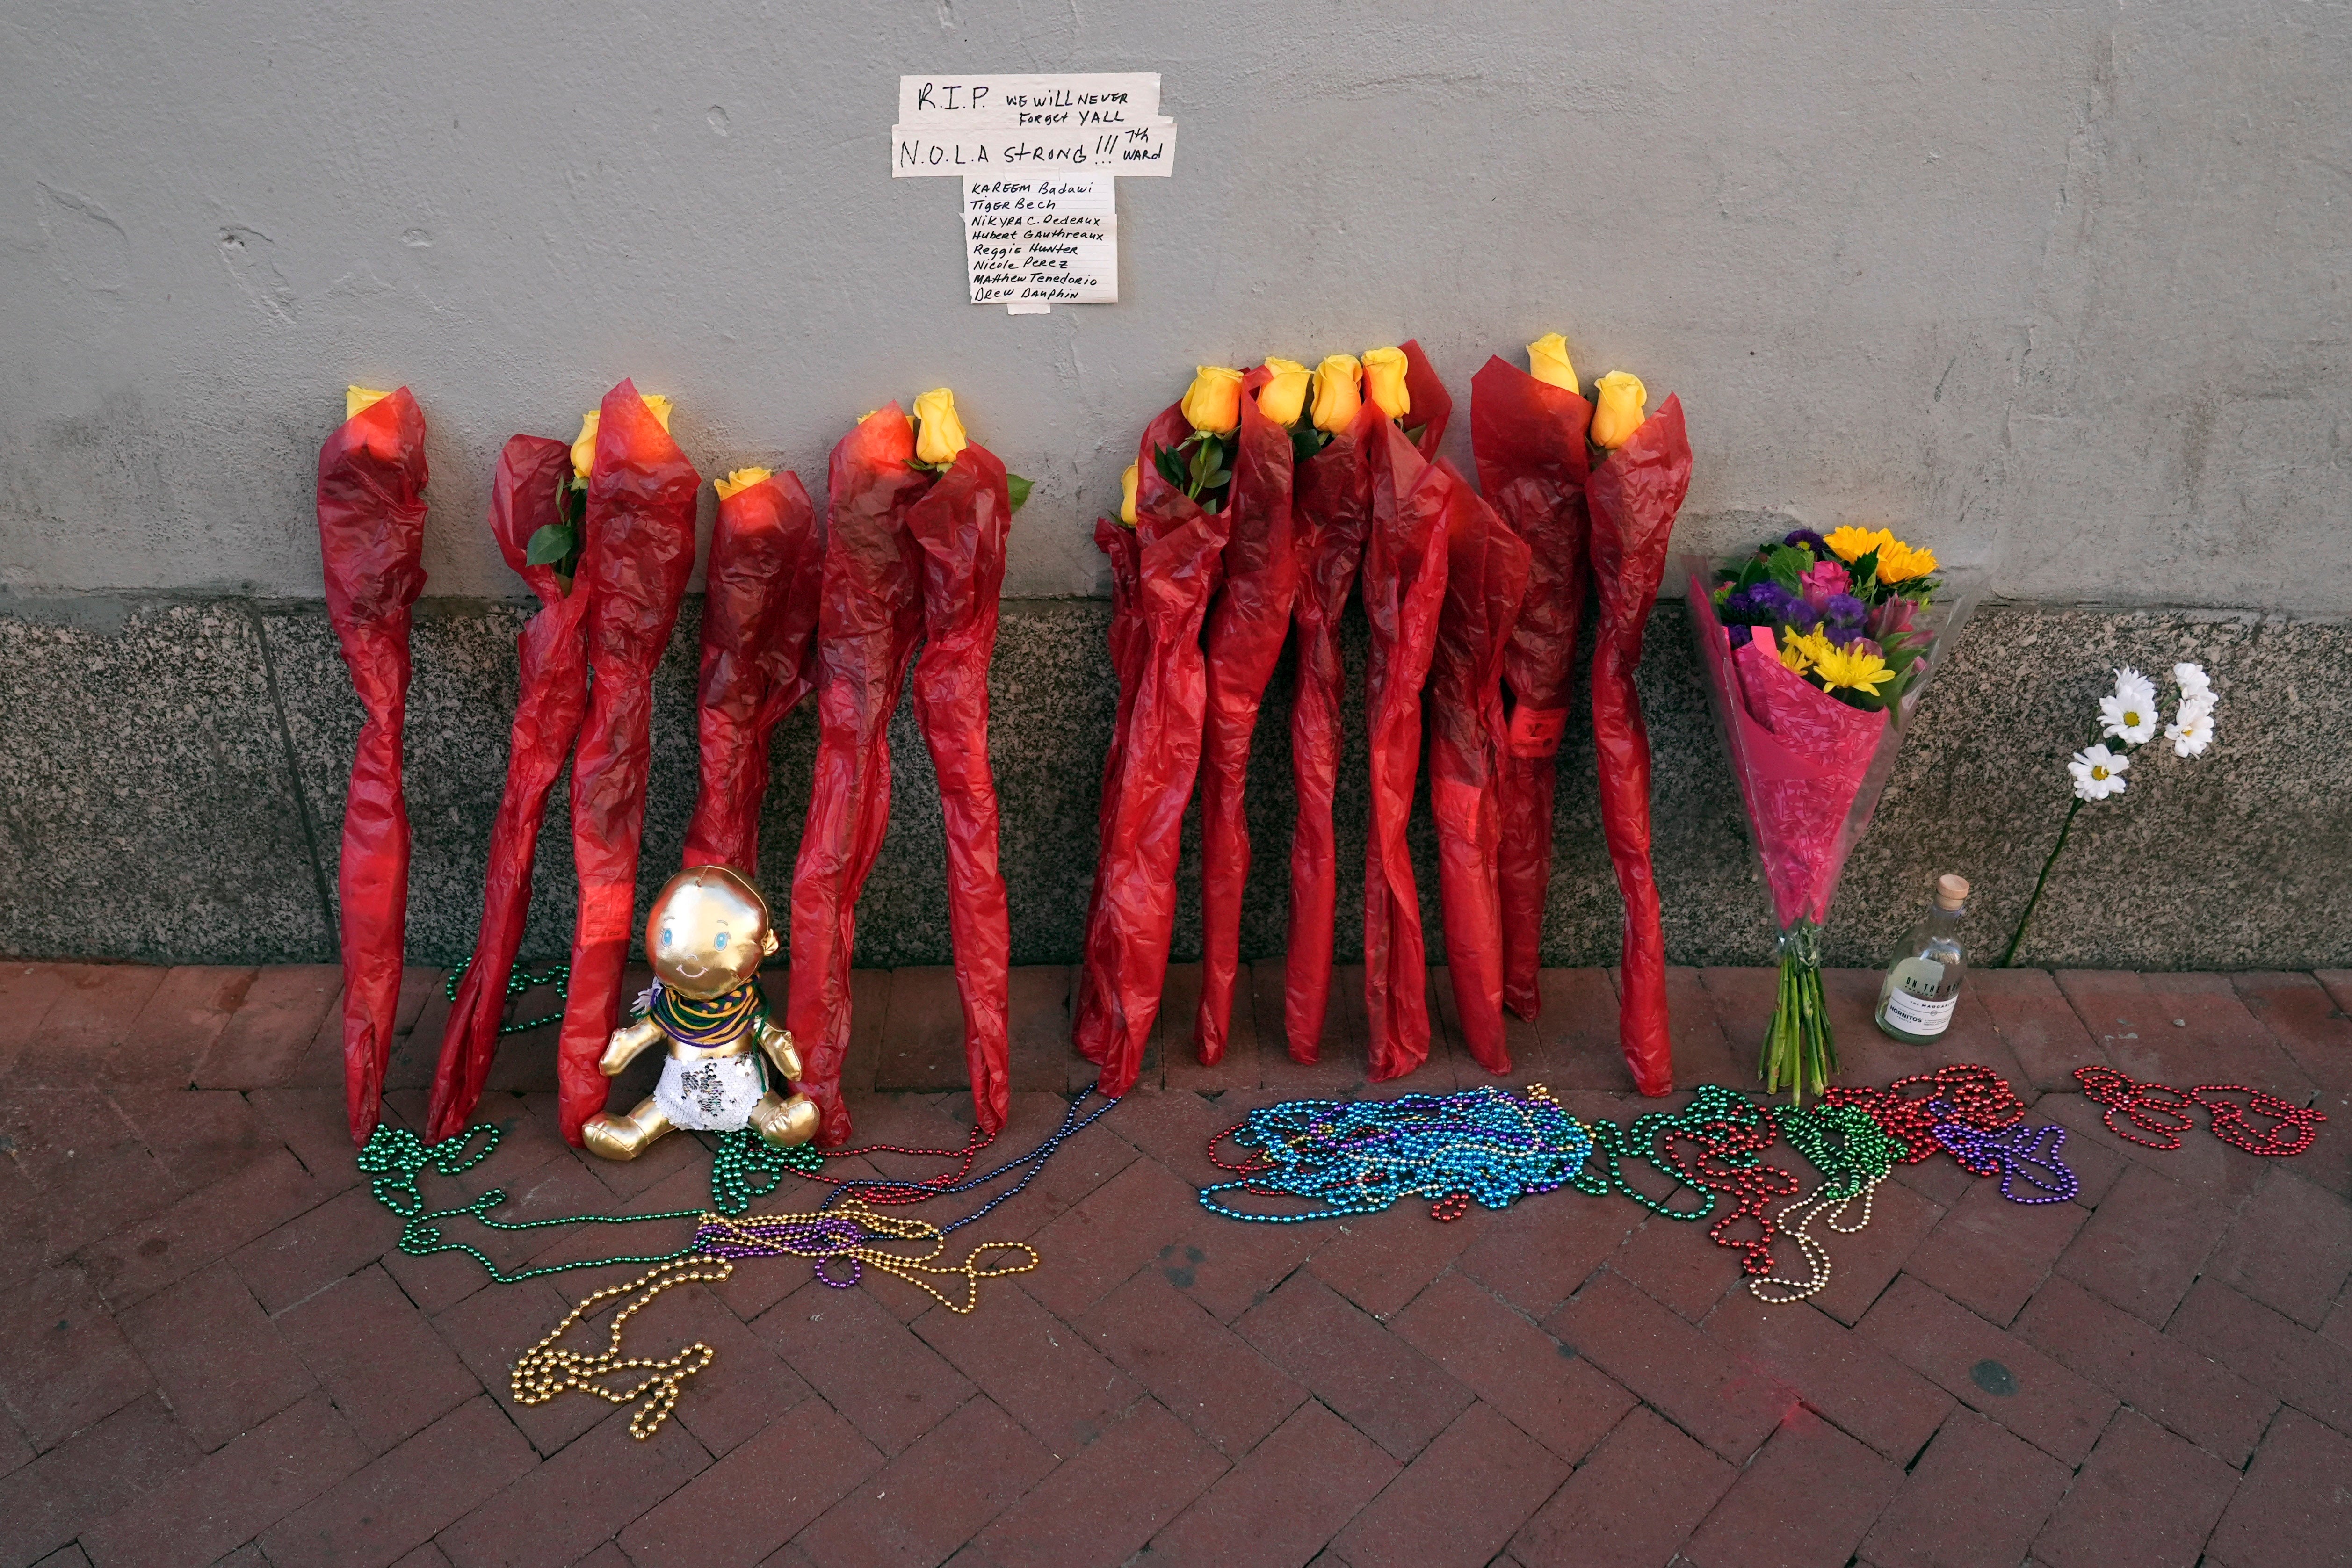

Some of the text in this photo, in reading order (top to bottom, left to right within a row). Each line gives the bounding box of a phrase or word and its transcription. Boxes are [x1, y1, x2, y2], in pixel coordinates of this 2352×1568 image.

[919, 82, 989, 111] R.I.P.
[1006, 95, 1028, 108] WE
[1077, 92, 1128, 105] NEVER
[1078, 110, 1125, 127] YALL
[971, 181, 1093, 195] KAREEM Badawi
[1014, 197, 1056, 210] Bech
[1027, 216, 1040, 225] C.
[973, 259, 1019, 271] Nicole
[1906, 977, 1917, 988] ON
[1924, 984, 1941, 993] THE
[1890, 1005, 1923, 1023] HORNITOS
